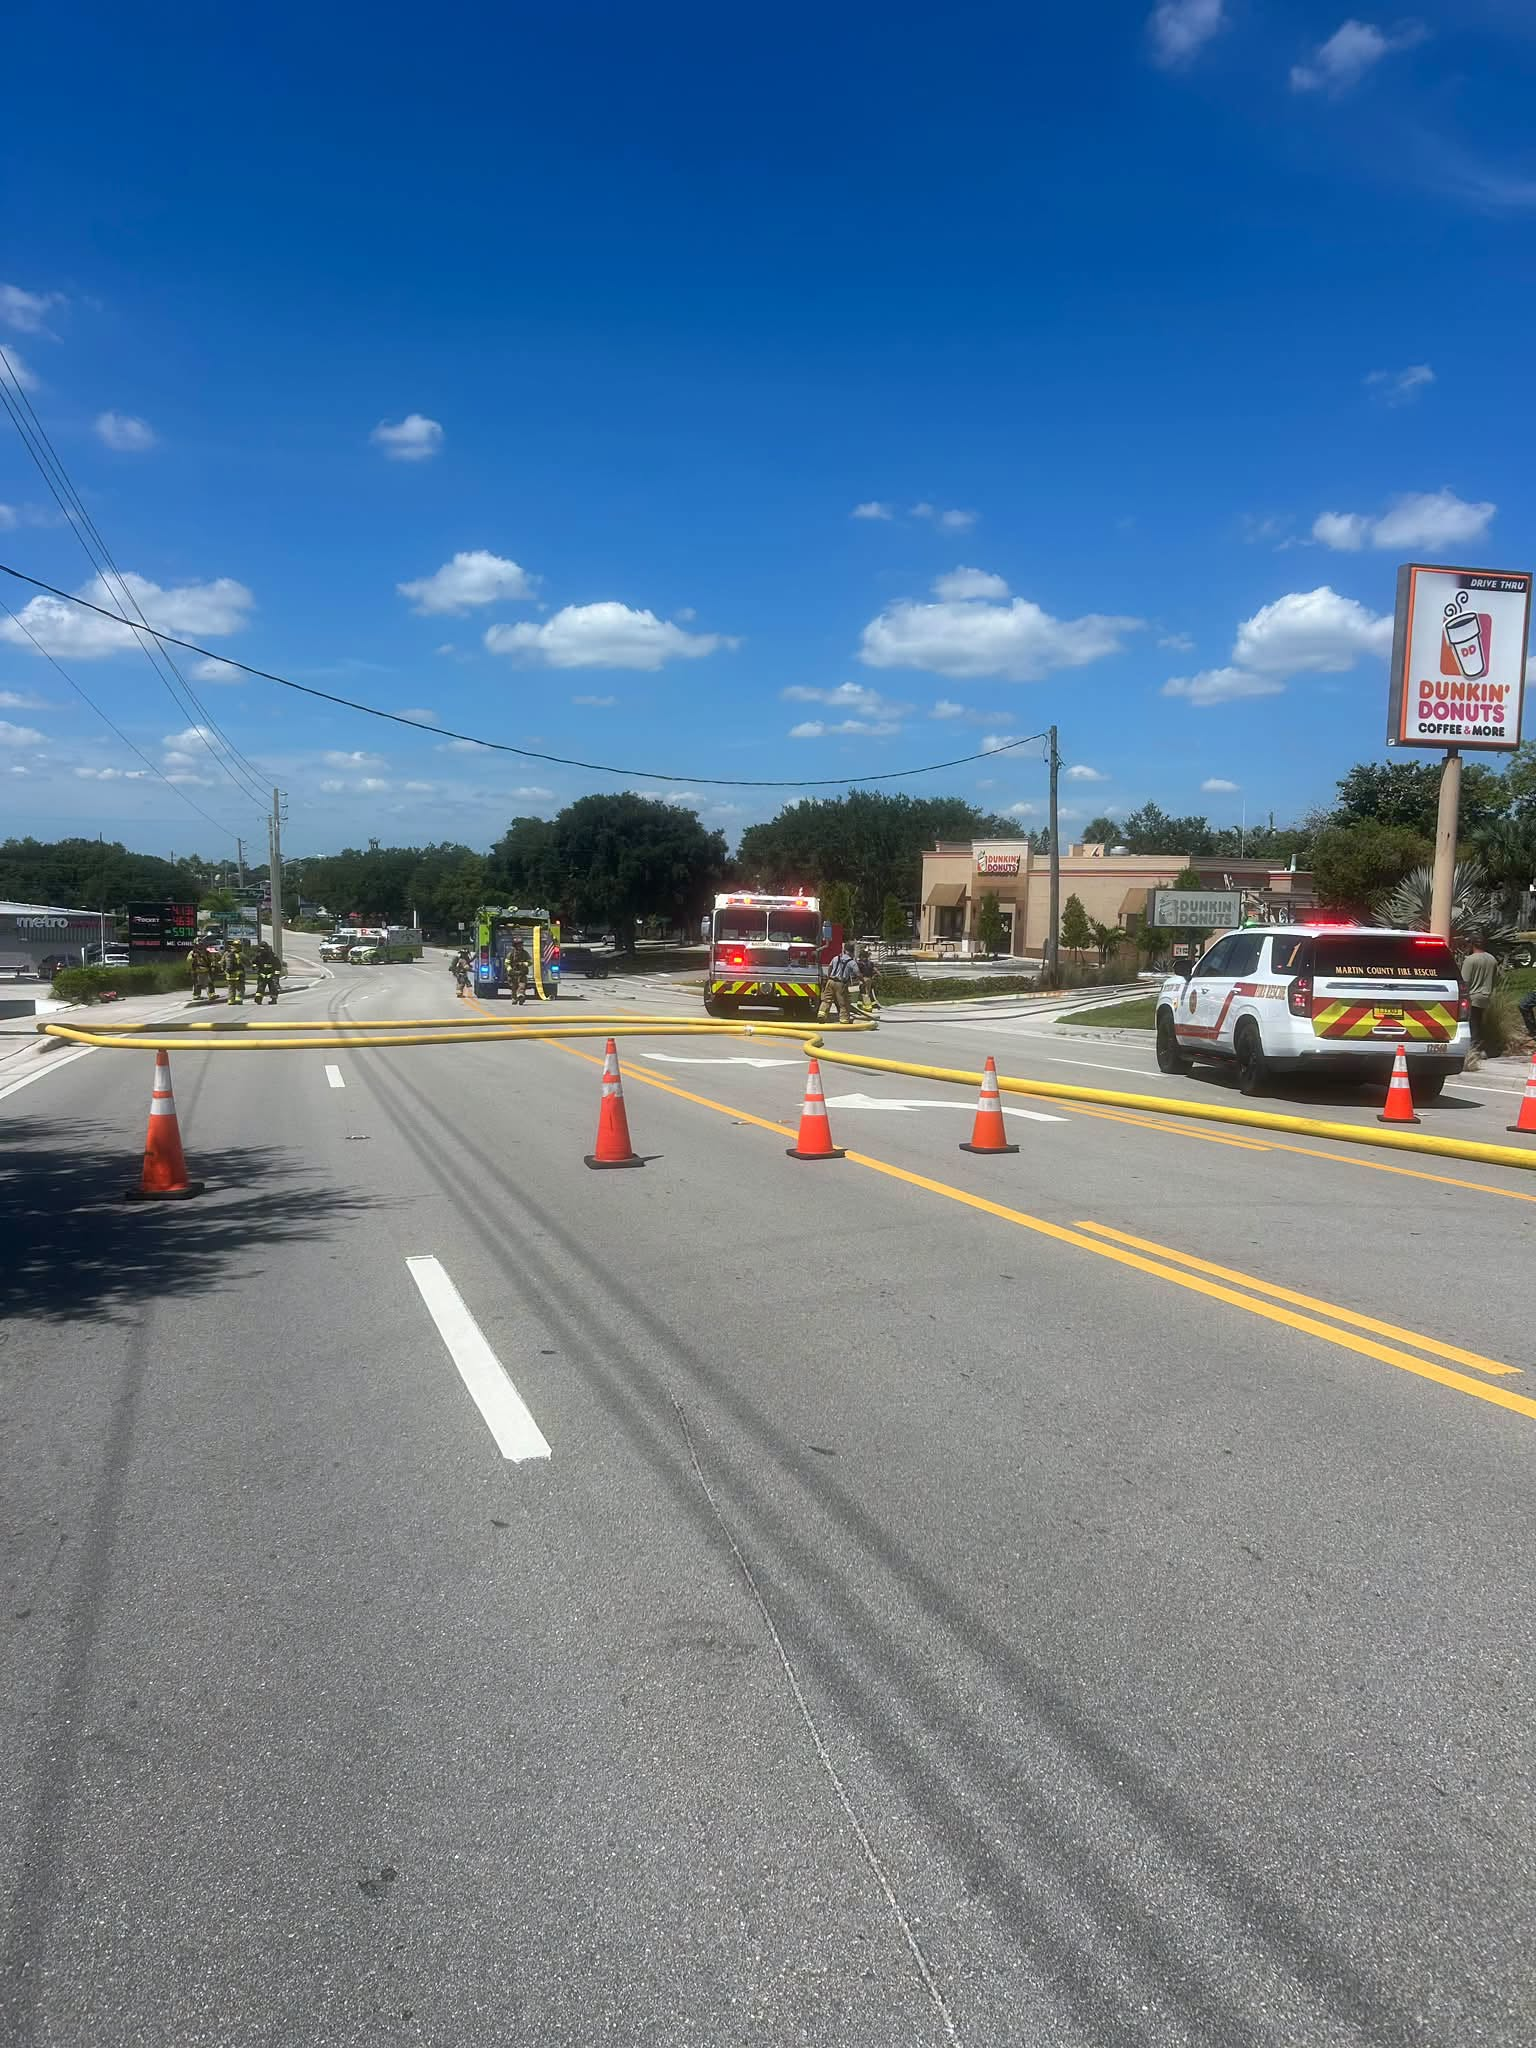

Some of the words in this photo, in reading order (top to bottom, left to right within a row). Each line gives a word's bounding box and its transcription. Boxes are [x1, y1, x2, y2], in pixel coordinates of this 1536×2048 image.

[1470, 579, 1498, 588] DRIVE
[1500, 581, 1525, 590] THRU
[1461, 645, 1476, 657] DD
[1419, 680, 1510, 703] DUNKIN'
[1418, 700, 1505, 723] DONUTS
[1418, 722, 1462, 735] COFFEE
[1464, 726, 1471, 735] &
[1472, 725, 1505, 737] MORE
[988, 864, 1017, 872] DONUTS
[16, 915, 69, 928] metro
[1179, 912, 1232, 925] DONUTS
[1335, 966, 1364, 975] MARTIN
[1366, 966, 1394, 975] COUNTY
[1397, 967, 1412, 976] FIRE
[1414, 968, 1438, 977] RESCUE
